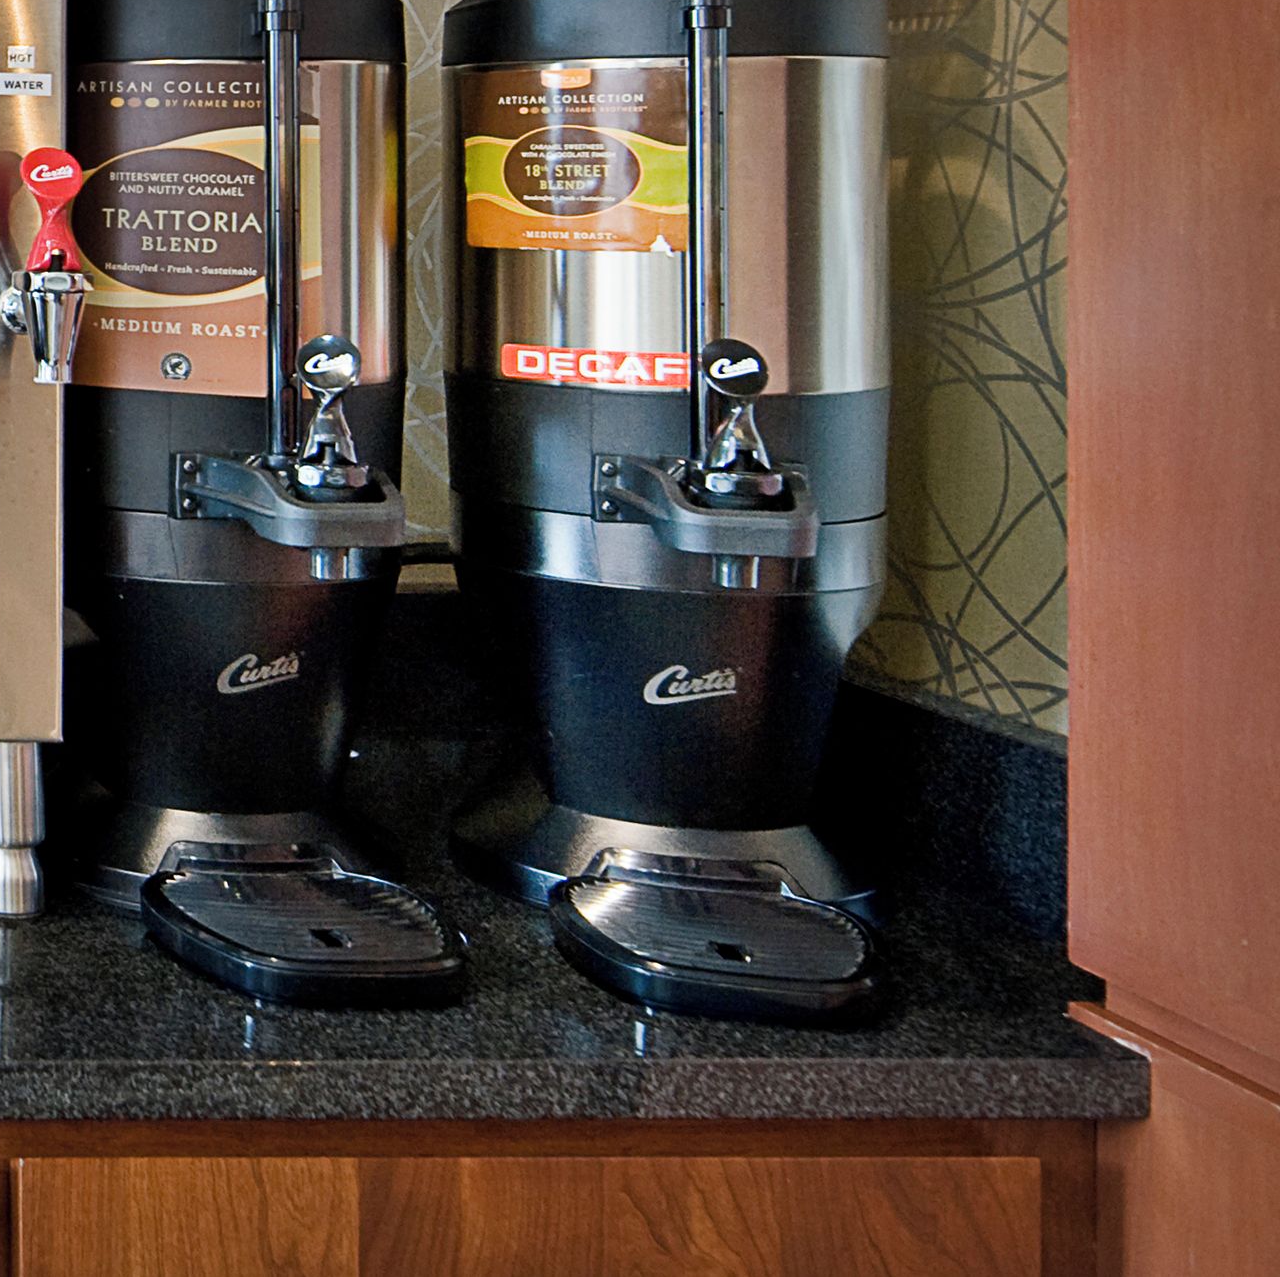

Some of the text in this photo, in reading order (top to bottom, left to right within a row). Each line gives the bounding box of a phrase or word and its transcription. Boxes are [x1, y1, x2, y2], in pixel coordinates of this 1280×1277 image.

[9, 53, 33, 64] HOT
[4, 80, 44, 90] WATER
[77, 81, 262, 95] ARTISAN COLLECTI
[165, 99, 263, 109] BY FARMER BROT
[498, 93, 644, 106] ARTISAN COLLECTION
[555, 164, 612, 177] STREET
[109, 172, 256, 185] BITTERSWEET CHOCOLATE
[539, 180, 586, 190] BLEND
[119, 185, 245, 197] AND NUTTY CARAMEL
[102, 208, 263, 234] TRATTORIA
[526, 231, 613, 240] MEDIUM ROAST
[141, 236, 218, 253] BLEND
[105, 262, 258, 276] Handcrafted Fresh Sustainable
[99, 318, 261, 339] MEDIUM ROAST
[517, 350, 686, 382] DECAF
[217, 653, 301, 695] Curtis
[643, 665, 738, 706] Curtis
